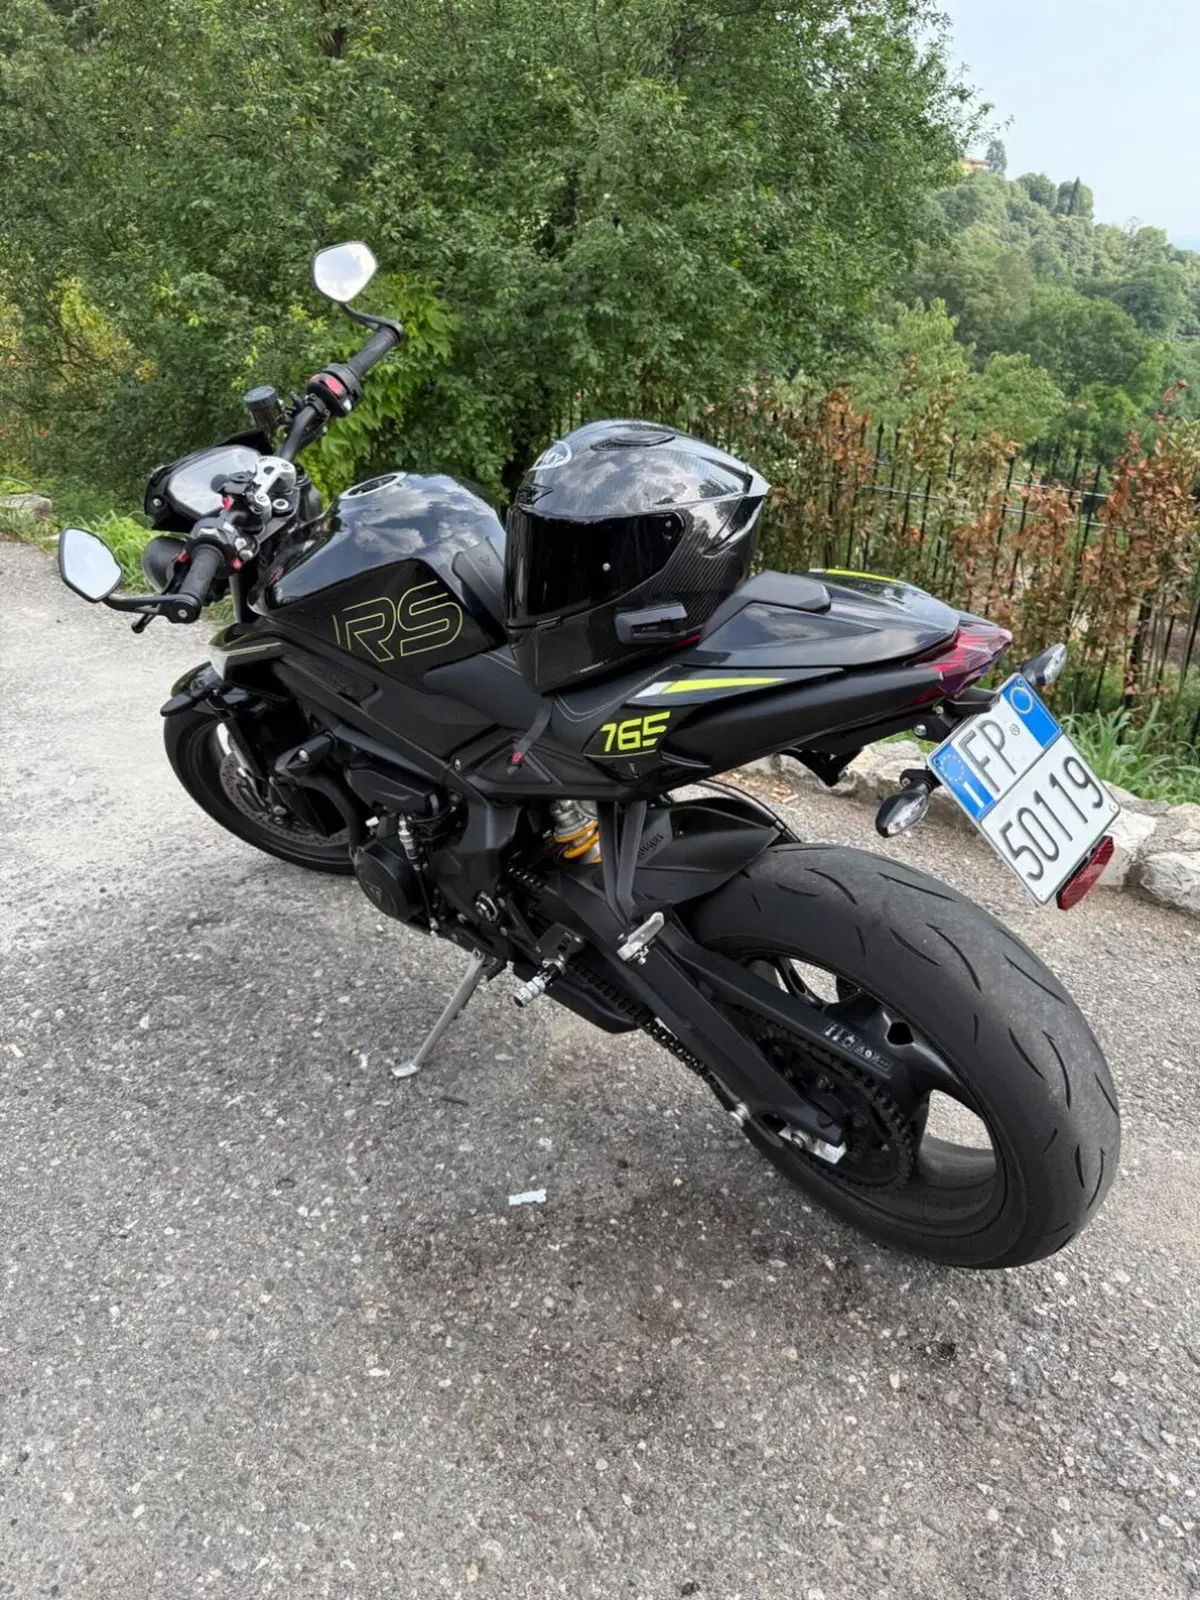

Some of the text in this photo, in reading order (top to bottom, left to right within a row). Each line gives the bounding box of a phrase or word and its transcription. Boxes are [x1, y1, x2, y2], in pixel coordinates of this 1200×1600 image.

[332, 580, 463, 662] RS
[600, 711, 671, 752] 765
[957, 719, 1017, 793] FP
[963, 781, 985, 809] I
[1000, 756, 1104, 881] 50119
